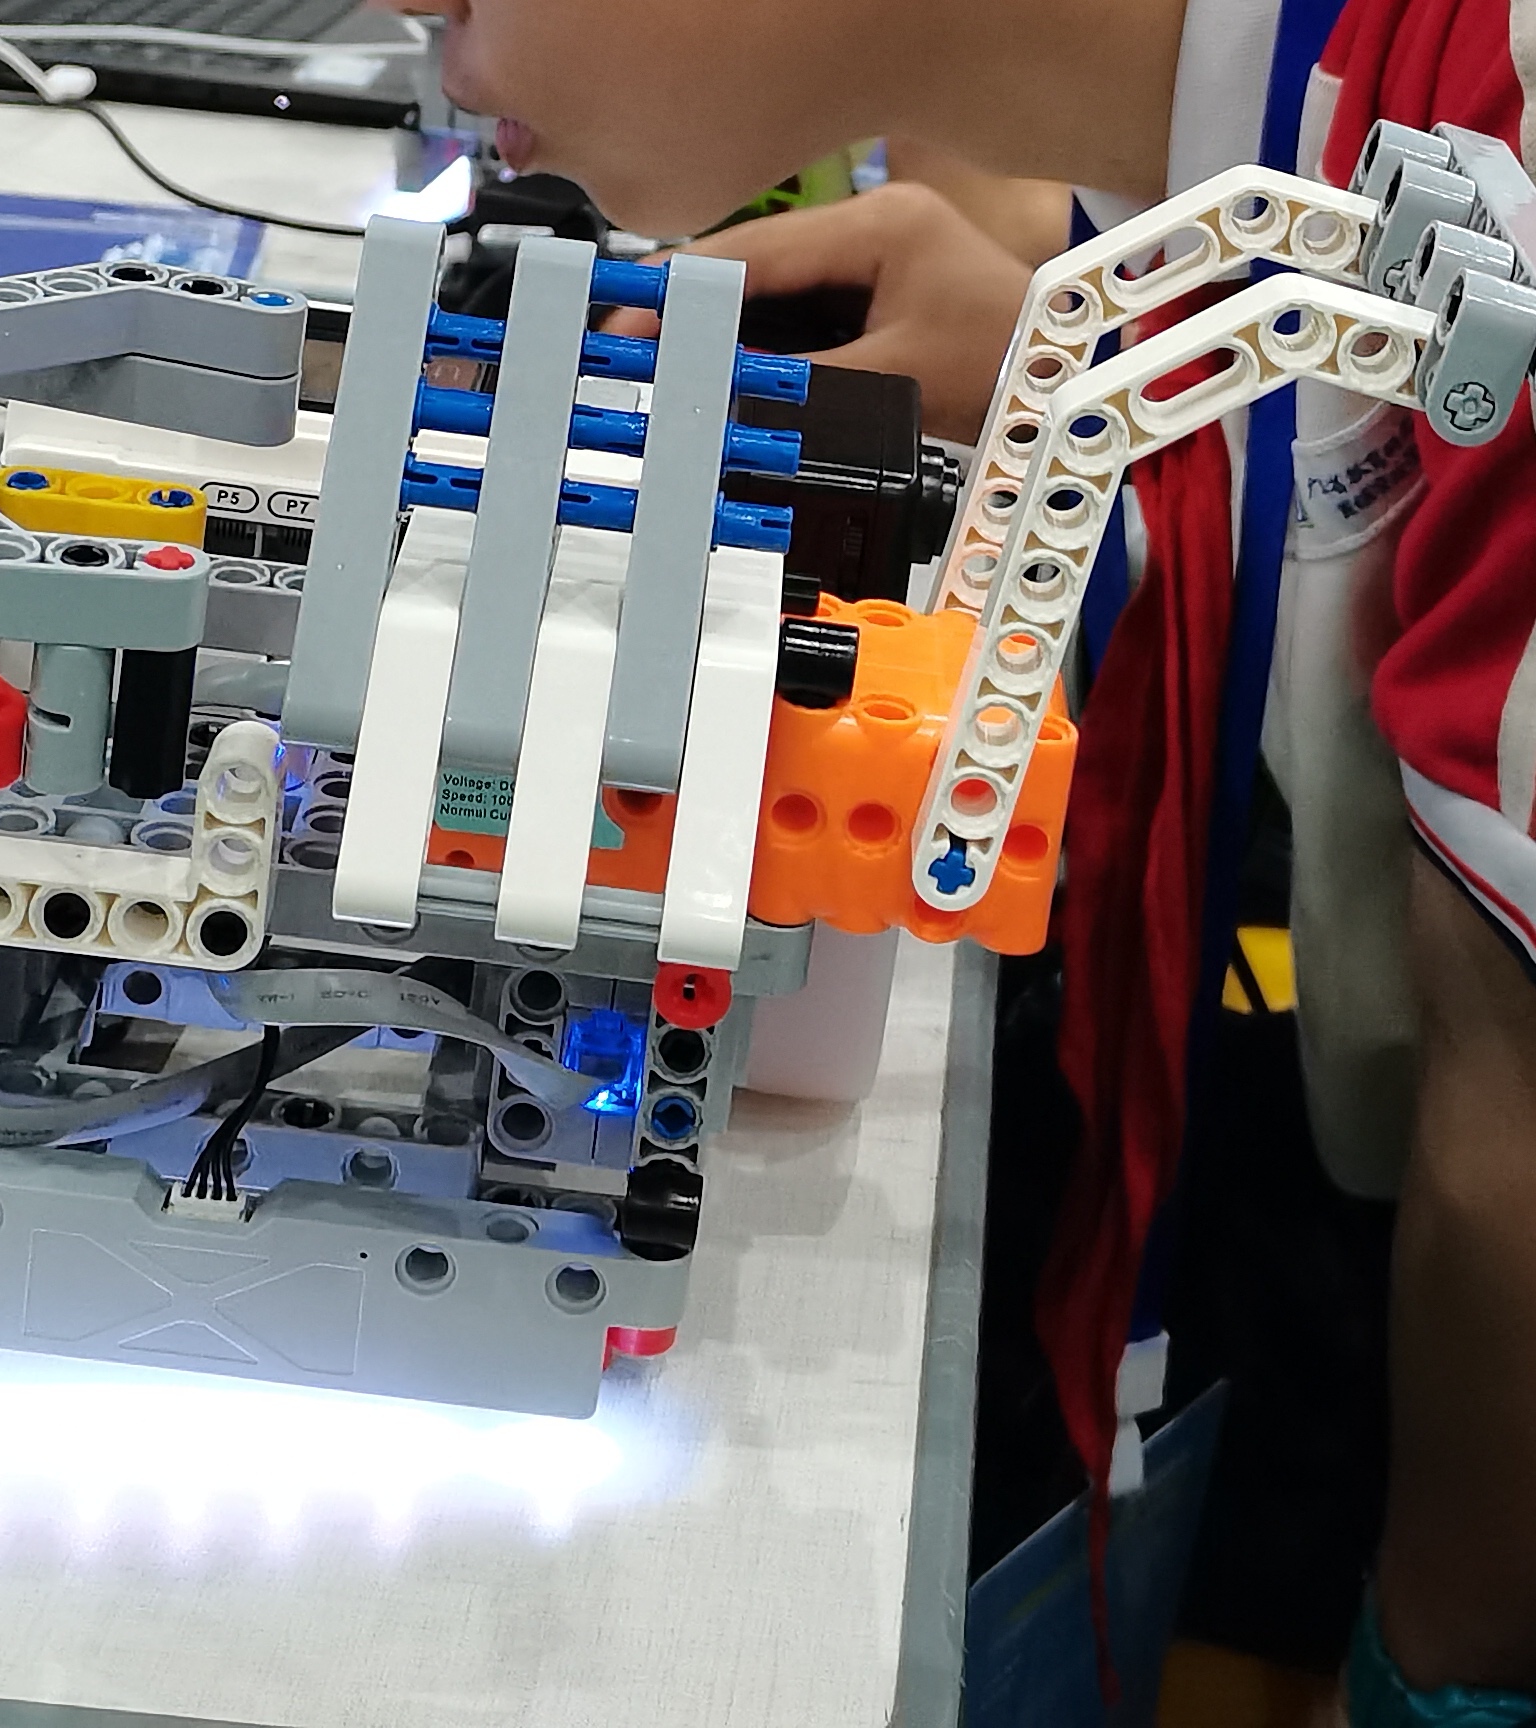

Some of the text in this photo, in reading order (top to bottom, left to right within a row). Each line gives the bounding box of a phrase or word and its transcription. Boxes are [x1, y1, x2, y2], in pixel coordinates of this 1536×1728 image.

[216, 489, 241, 506] P5
[285, 499, 310, 516] P7
[441, 789, 487, 804] Speed:
[440, 804, 486, 819] Normal
